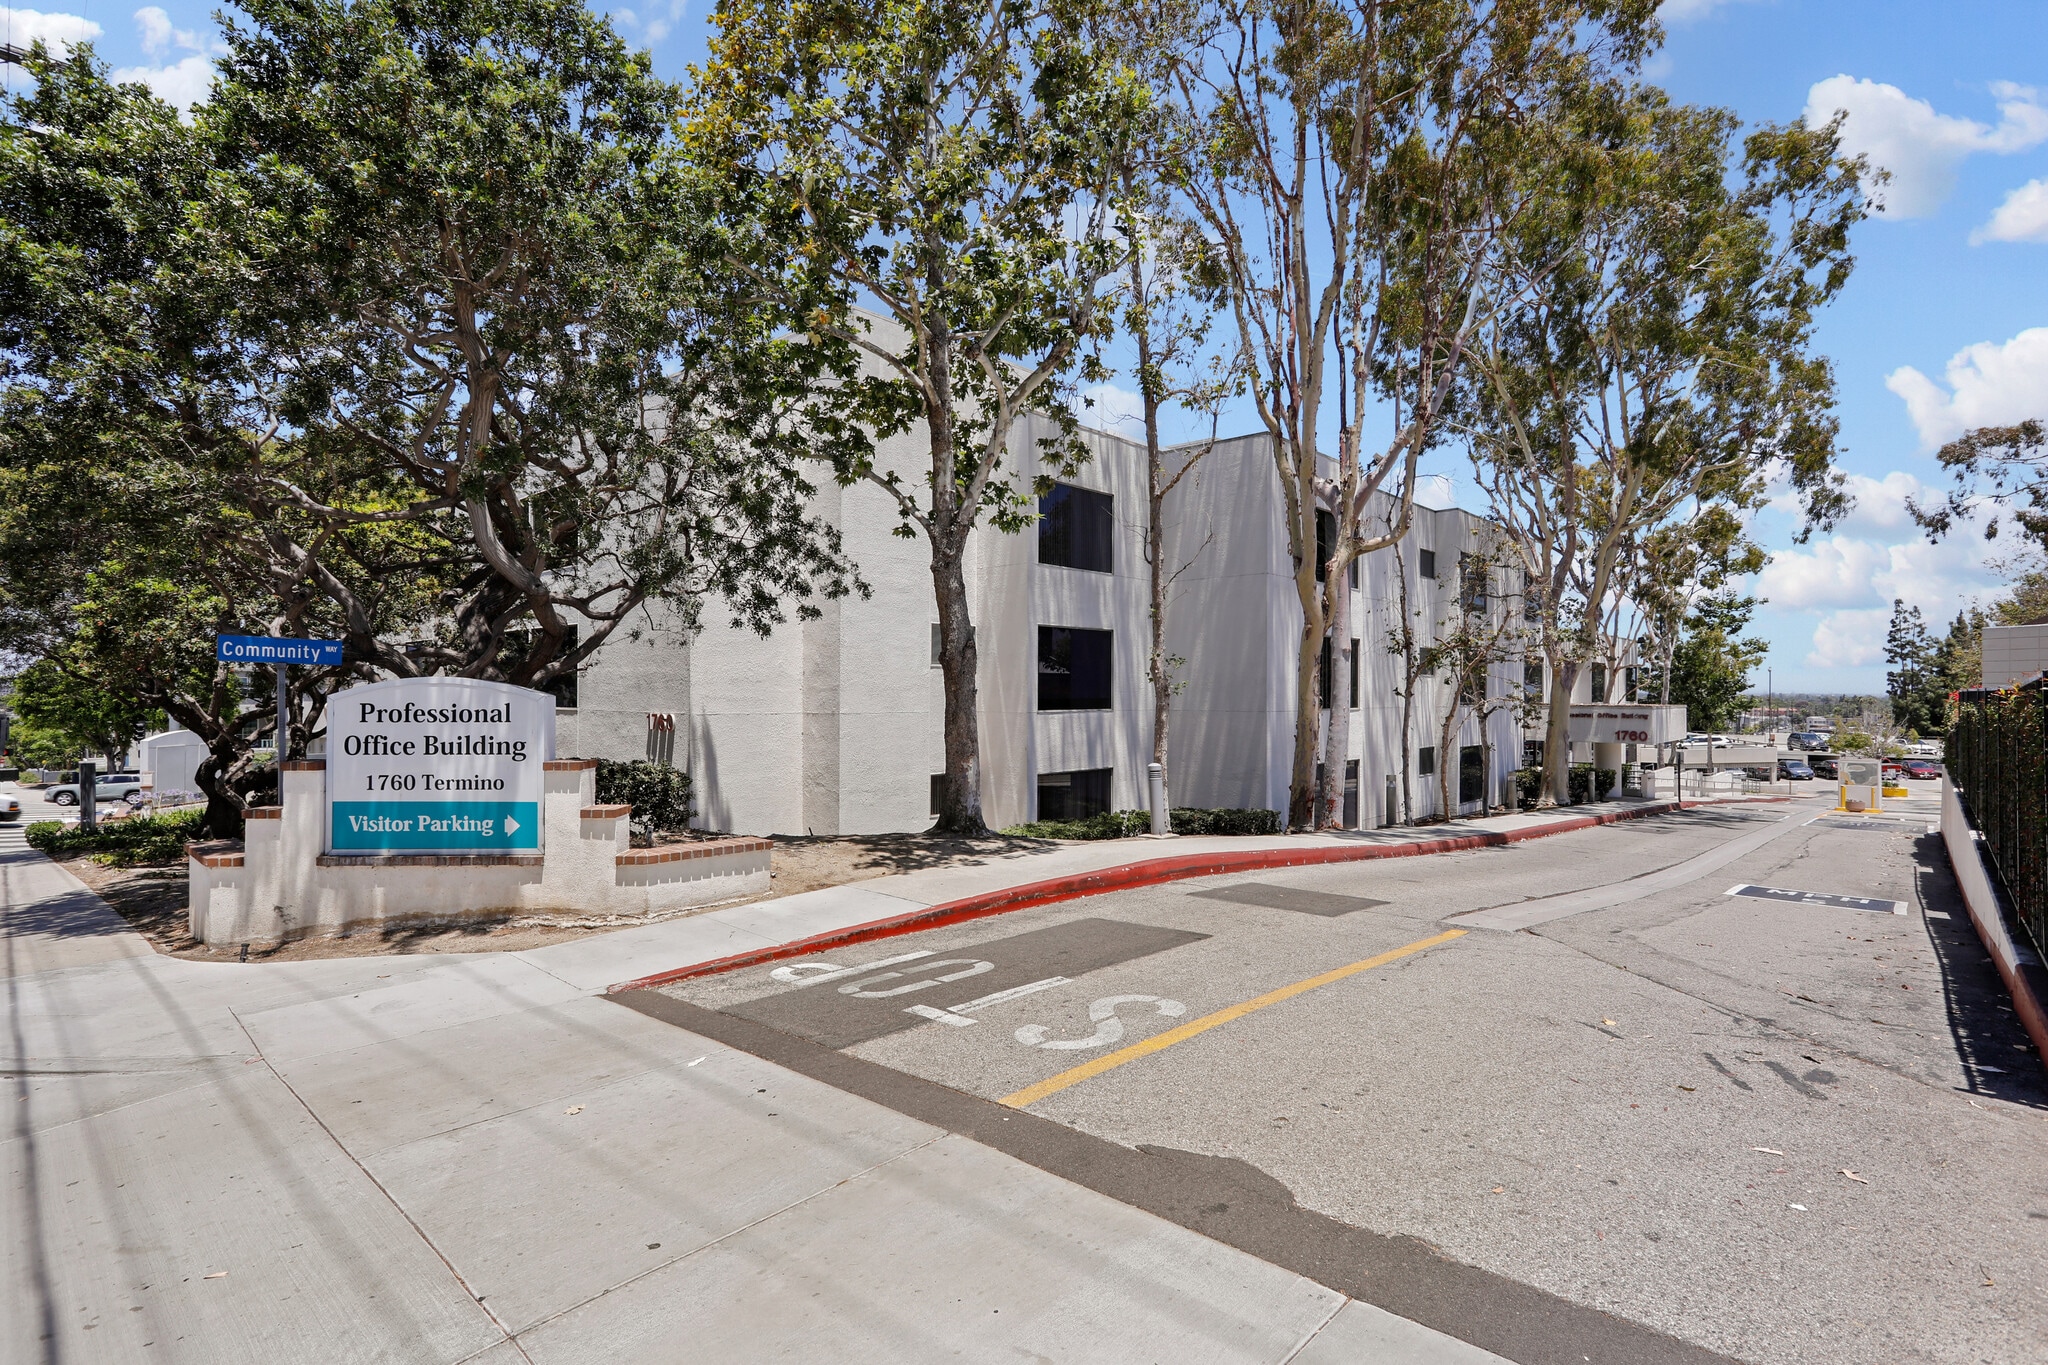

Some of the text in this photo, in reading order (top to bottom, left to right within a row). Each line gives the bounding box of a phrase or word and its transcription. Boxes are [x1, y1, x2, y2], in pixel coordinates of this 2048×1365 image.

[222, 641, 338, 662] Community WAY
[359, 702, 512, 724] Professional
[646, 713, 674, 732] 1760
[1614, 730, 1648, 742] 1760
[344, 735, 527, 761] Office Building
[365, 774, 505, 791] 1760 Termino
[348, 814, 494, 836] Visitor Parking
[769, 950, 1188, 1051] STOP
